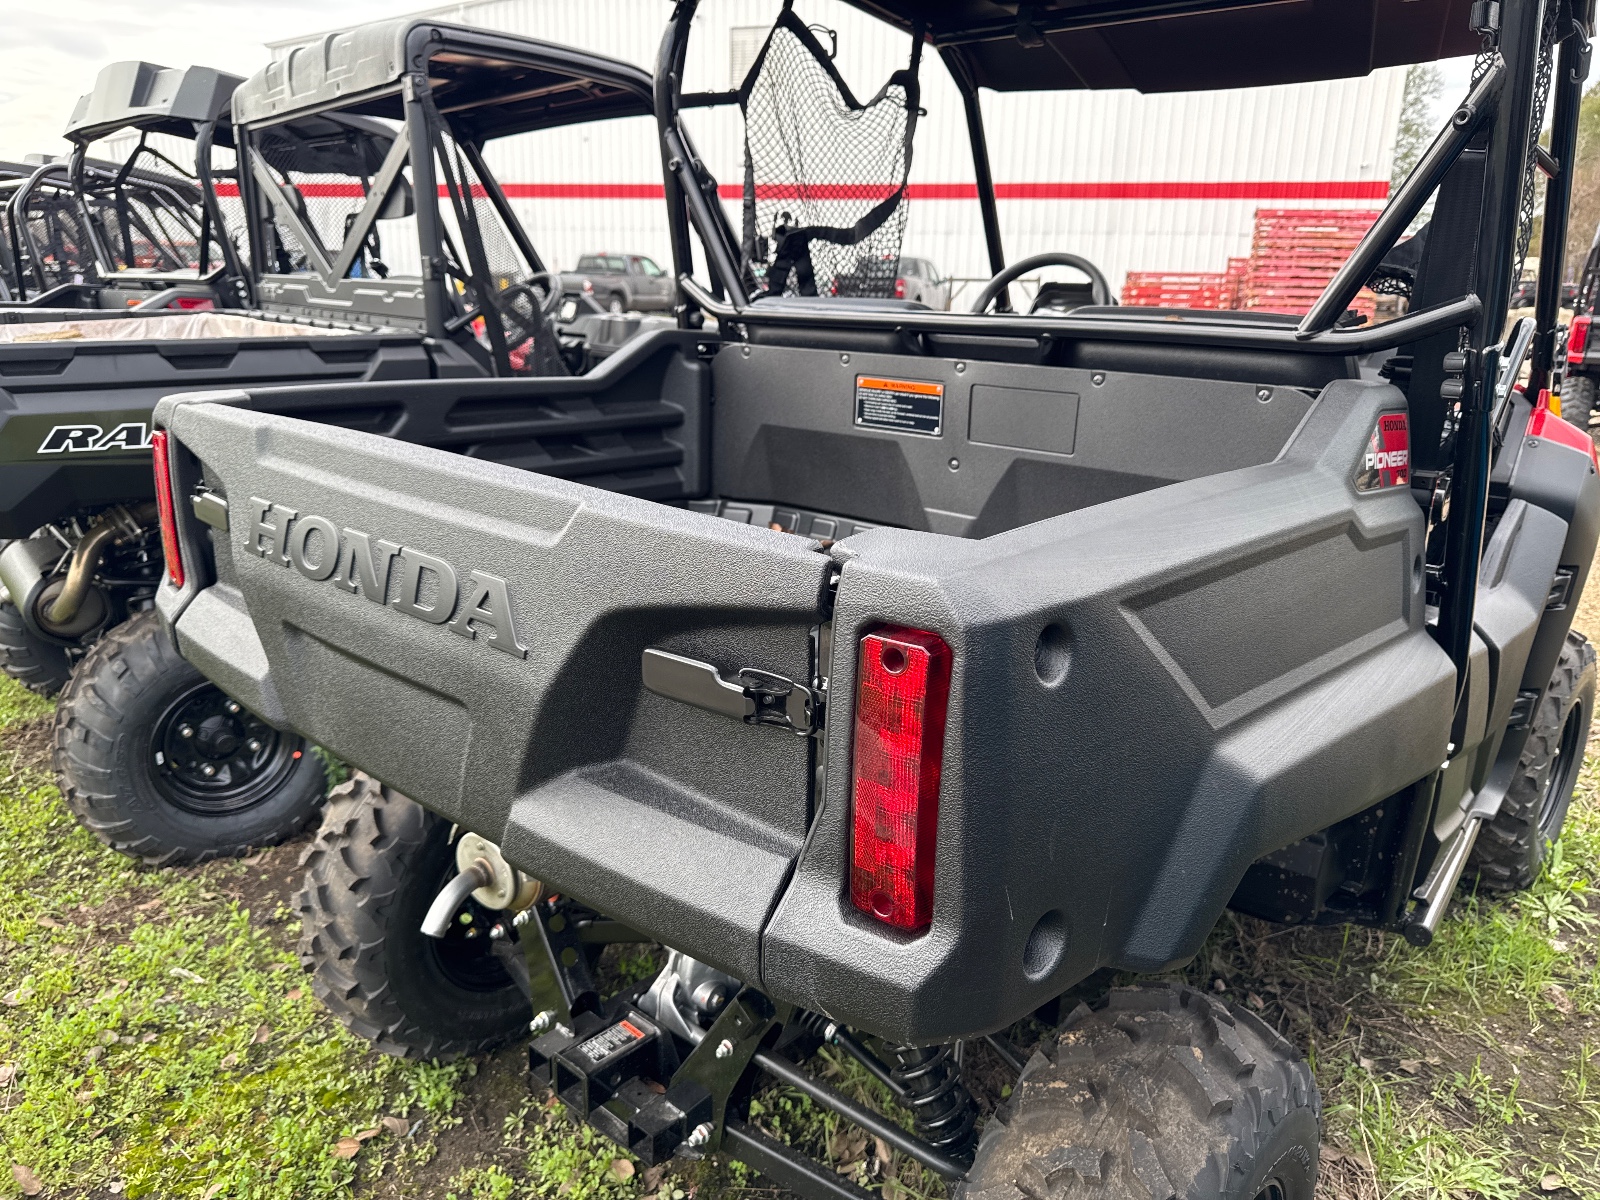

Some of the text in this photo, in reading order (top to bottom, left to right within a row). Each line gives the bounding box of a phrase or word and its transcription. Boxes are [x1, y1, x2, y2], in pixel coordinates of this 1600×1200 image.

[1383, 420, 1407, 431] HONDA
[1365, 450, 1408, 470] PIONEER
[244, 496, 528, 660] HONDA
